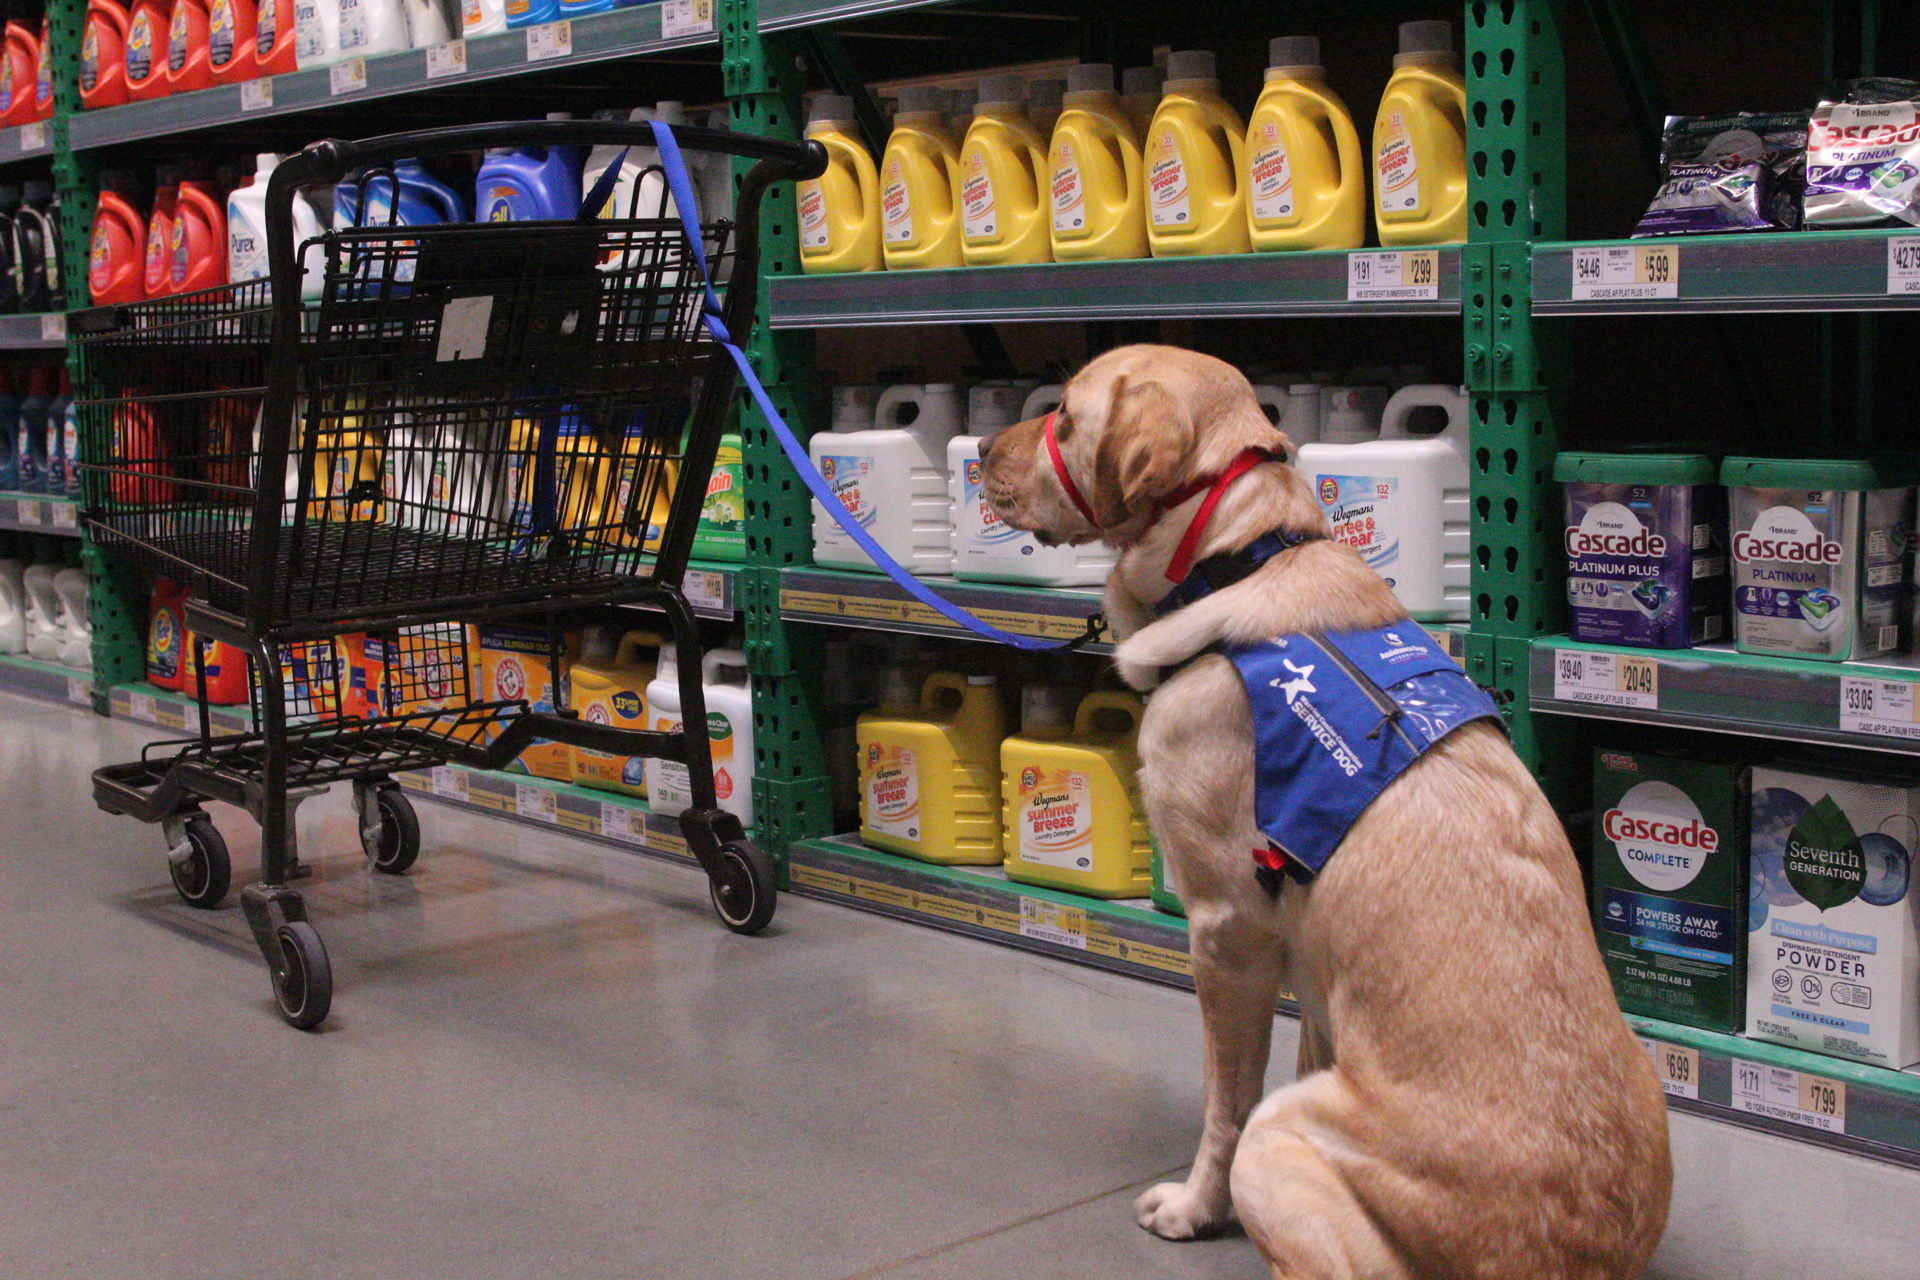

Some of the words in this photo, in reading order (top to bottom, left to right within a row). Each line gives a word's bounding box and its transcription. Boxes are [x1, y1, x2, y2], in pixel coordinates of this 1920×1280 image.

[1393, 114, 1400, 123] 33
[1266, 125, 1274, 134] 33
[1808, 112, 1920, 152] Cascad
[1254, 148, 1280, 166] Wegmans
[1381, 139, 1405, 158] Wegmans
[1832, 148, 1897, 162] PLATINUM
[1669, 167, 1718, 177] PLATINUM
[231, 233, 256, 253] Purex
[1411, 258, 1431, 284] $2.99
[1577, 257, 1600, 278] $54.46
[1645, 255, 1669, 282] $5.99
[1363, 289, 1386, 298] DETERGENT
[1590, 289, 1611, 298] CASCADE
[1619, 288, 1630, 297] PLAT
[1631, 288, 1642, 297] PLUS
[1650, 288, 1657, 296] CT
[1376, 484, 1389, 494] 132
[1632, 487, 1647, 498] 52
[1807, 492, 1823, 502] 62
[1331, 504, 1374, 526] Wegmans
[1365, 516, 1375, 530] &
[981, 524, 998, 535] Laundry
[1775, 527, 1798, 535] BRAND
[1566, 527, 1665, 557] Cascade
[1733, 531, 1842, 563] Cascade
[1568, 560, 1625, 576] PLATINUM
[1628, 564, 1660, 577] PLUS
[1752, 568, 1816, 584] PLATINUM
[1559, 658, 1582, 680] $39.40
[1623, 665, 1652, 693] $20.49
[1572, 691, 1593, 701] CASCADE
[1845, 687, 1873, 711] $33.05
[1859, 722, 1873, 732] CASC
[1290, 700, 1337, 751] SERVICE
[1332, 748, 1359, 777] DOG
[660, 760, 689, 774] Sensitive
[1032, 792, 1070, 811] Wegmans
[1035, 831, 1053, 841] Laundry
[1053, 828, 1077, 839] Detergent
[1605, 809, 1716, 851] Cascade
[1627, 848, 1690, 869] COMPLETE
[1789, 840, 1860, 868] Seventh
[1789, 861, 1860, 882] GENERATION
[1636, 907, 1682, 925] POWERS
[1684, 916, 1719, 931] AWAY
[1636, 918, 1645, 927] 24
[1645, 920, 1656, 928] HR
[1657, 921, 1681, 933] STUCK
[1682, 926, 1694, 935] ON
[1775, 922, 1802, 937] Clean
[1802, 927, 1827, 941] with
[1829, 932, 1873, 949] Purpose
[1782, 941, 1822, 955] DISHWASHER
[1822, 949, 1861, 962] DETERGENT
[1776, 947, 1865, 978] POWDER
[1625, 966, 1638, 976] 2.12
[1638, 969, 1646, 979] kg
[1646, 971, 1657, 981] (75
[1682, 978, 1692, 987] LB
[1803, 978, 1820, 994] 0%
[1792, 1011, 1810, 1020] FREE
[1820, 1017, 1845, 1028] CLEAR
[1666, 1053, 1690, 1081] $6.99
[1739, 1069, 1759, 1092] $1.71
[1811, 1084, 1836, 1115] $7.99
[1802, 1114, 1815, 1125] FREE
[1822, 1119, 1830, 1129] OZ
